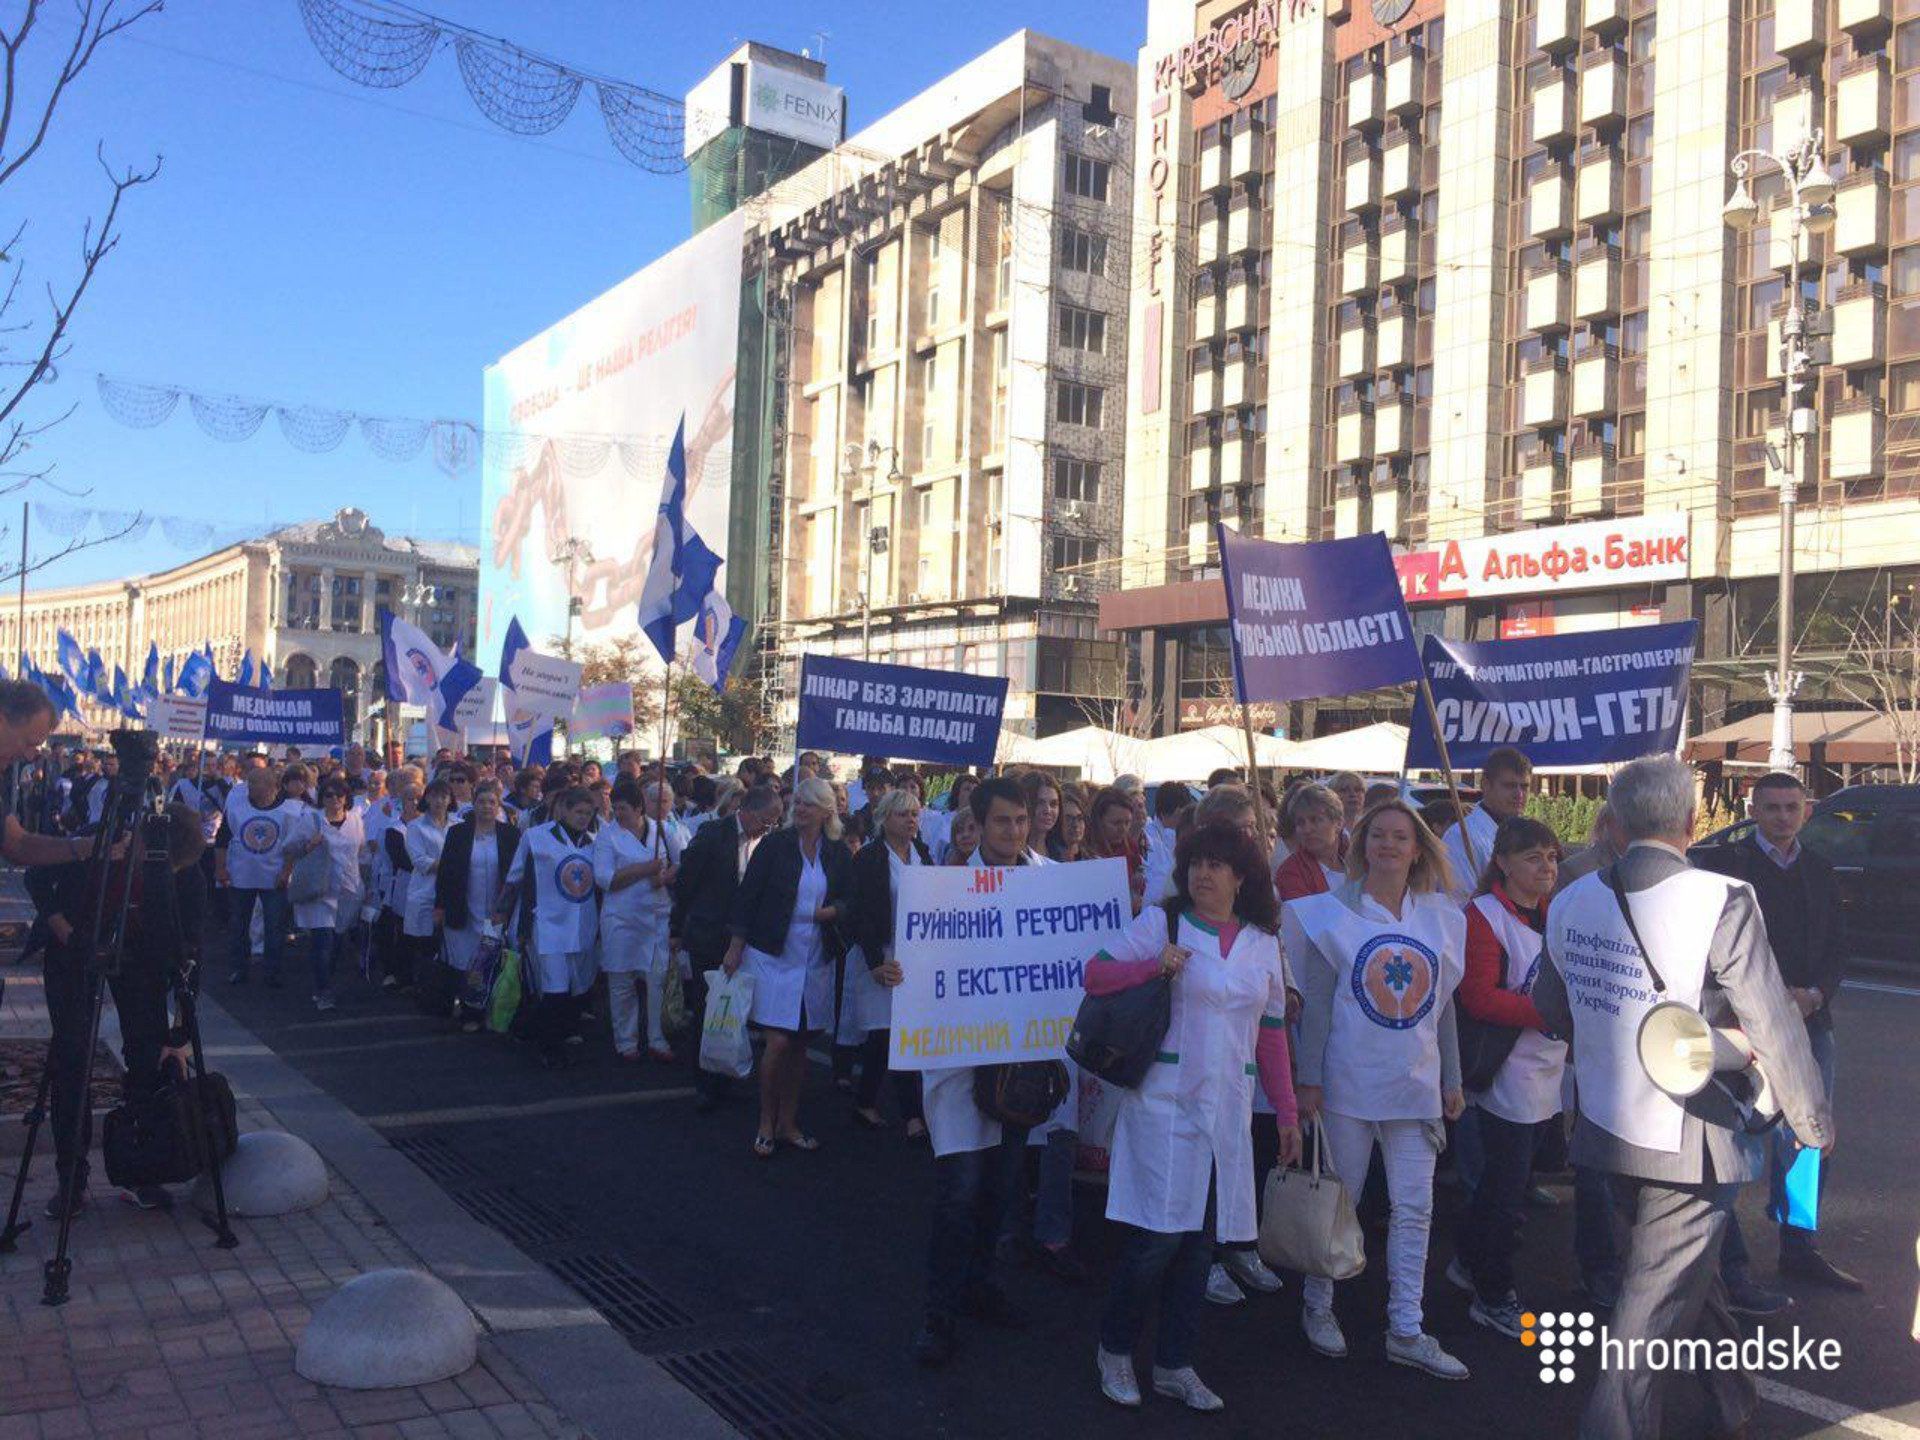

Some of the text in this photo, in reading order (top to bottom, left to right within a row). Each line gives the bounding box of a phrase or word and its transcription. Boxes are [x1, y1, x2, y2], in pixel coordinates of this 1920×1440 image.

[784, 94, 838, 125] FENIX
[1150, 118, 1170, 297] HOTEL
[1242, 573, 1307, 616] МЕДИКИ
[1302, 611, 1404, 655] ОБЛАСТІ
[232, 694, 313, 718] МЕДИКАМ
[805, 674, 998, 717] ЛІКАР БЕЗ ЗАРПЛАТИ
[1437, 687, 1678, 743] СУПРУН-ГЕТЬ
[210, 713, 245, 731] ГІДНУ
[246, 717, 294, 734] ОПЛАТУ
[296, 720, 340, 736] ПРАЦІ!
[835, 708, 976, 744] ГАНЬБА ВЛАДІ!
[1015, 898, 1122, 937] РЕФОРМІ
[935, 970, 946, 999] В
